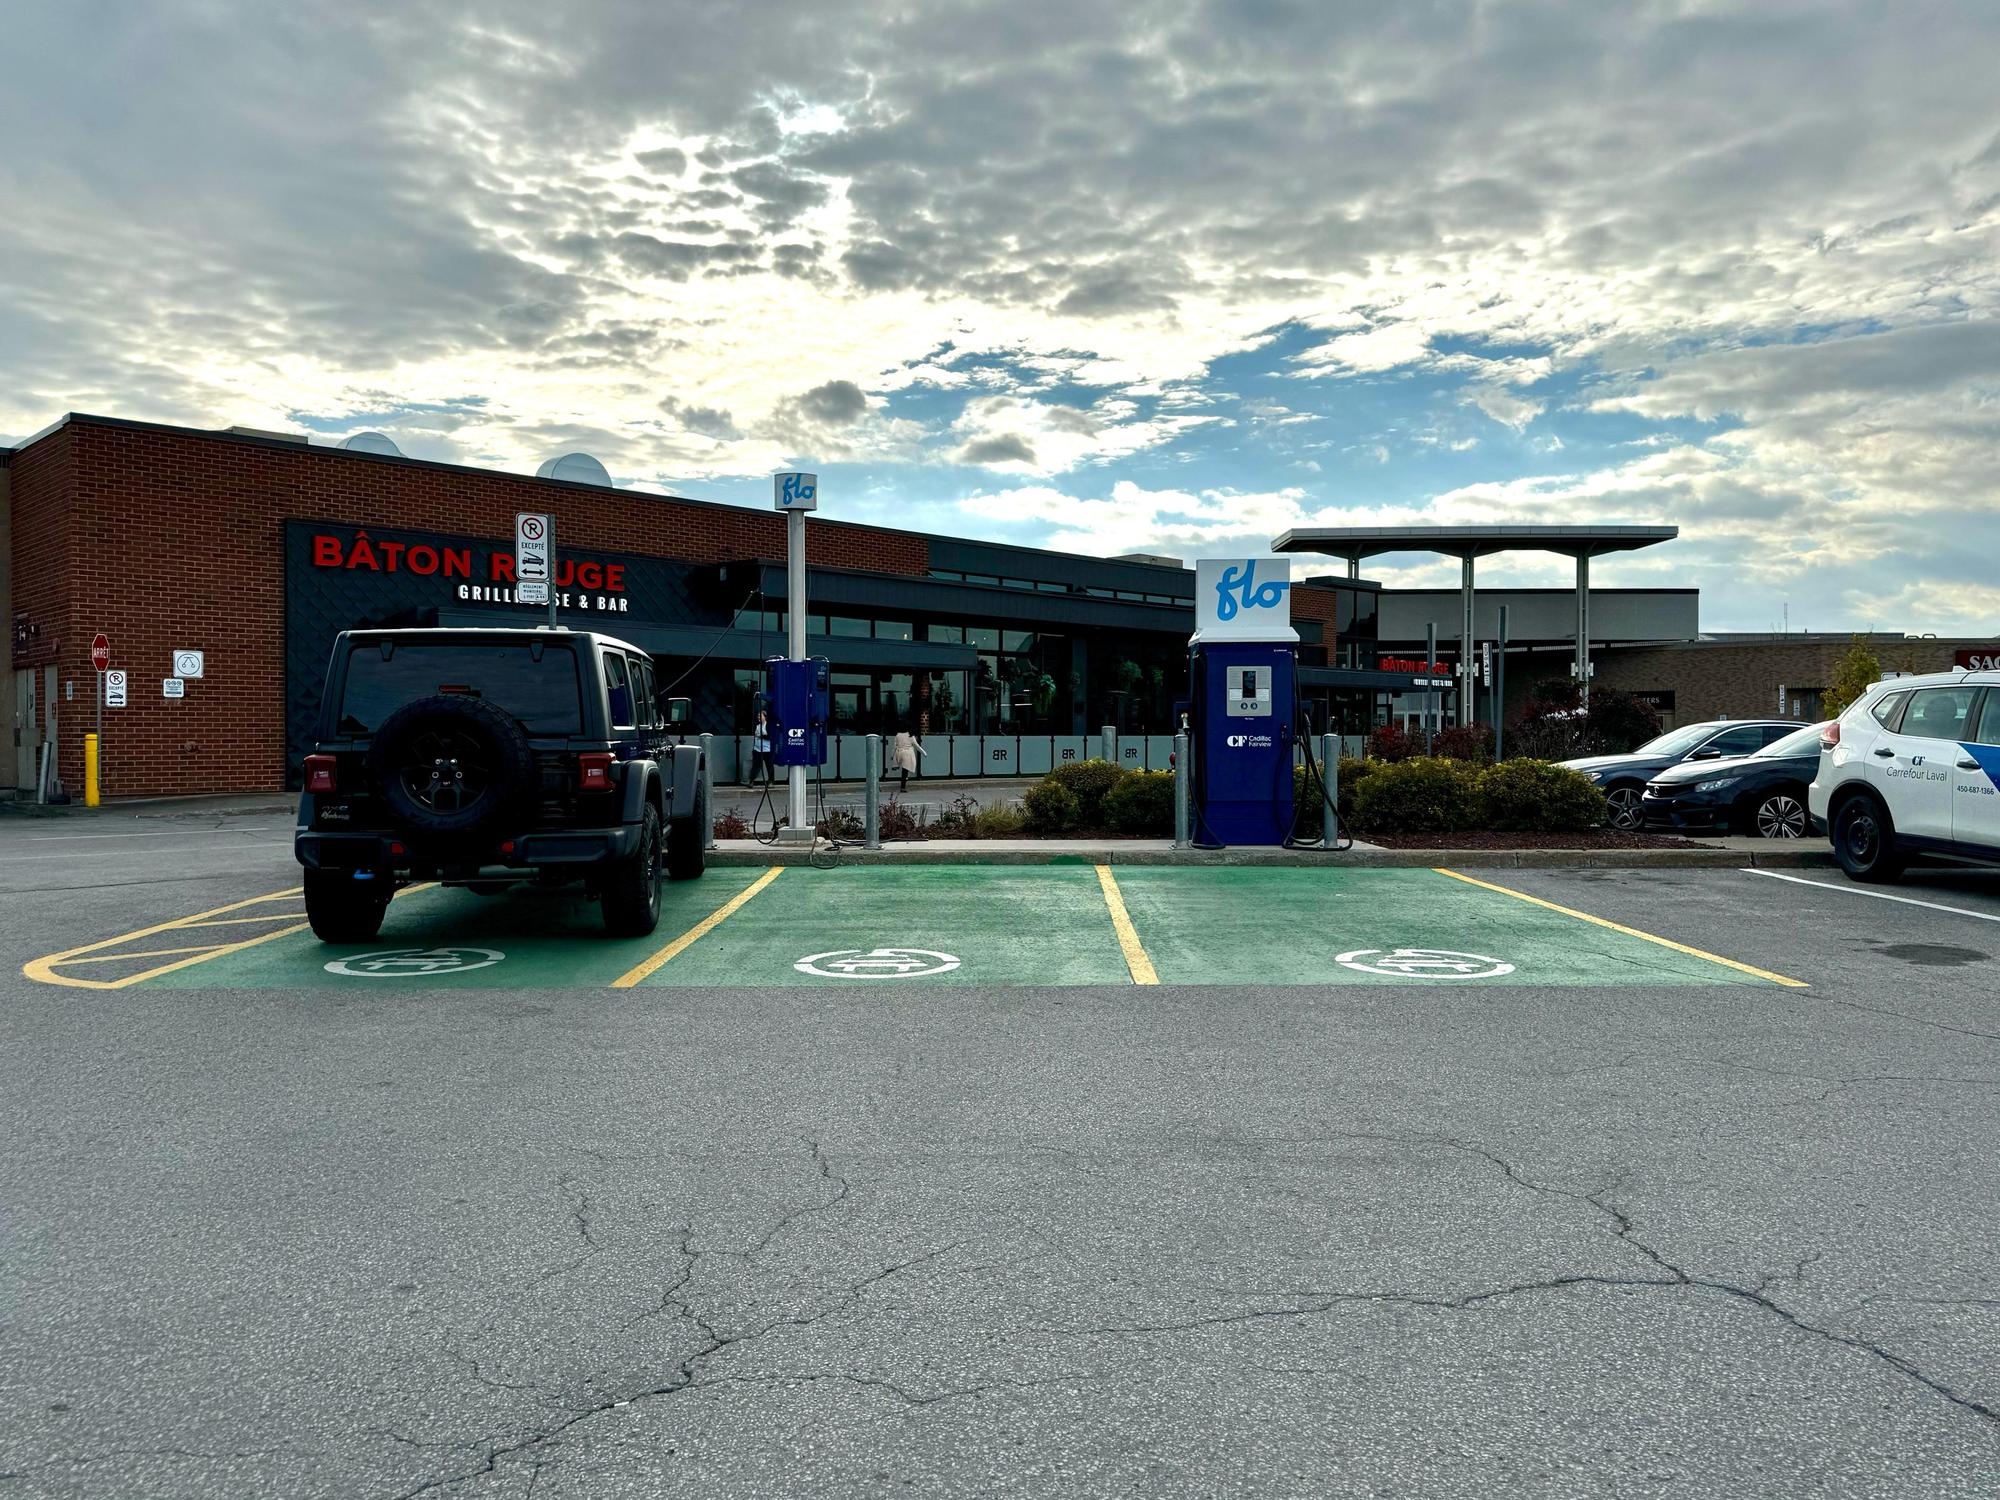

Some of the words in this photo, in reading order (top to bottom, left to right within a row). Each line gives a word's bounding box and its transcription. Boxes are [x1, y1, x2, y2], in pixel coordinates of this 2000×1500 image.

[782, 472, 815, 505] flo
[521, 541, 545, 551] EXCEPTÉ
[313, 530, 471, 578] BÂTON
[490, 552, 626, 592] RUGE
[1216, 559, 1290, 621] flo
[579, 594, 588, 609] &
[597, 596, 628, 612] BAR
[93, 645, 109, 658] ARRÊT
[1382, 655, 1414, 672] BÂTON
[788, 728, 805, 738] CF
[1227, 735, 1248, 747] CF
[1911, 755, 1926, 766] CF
[1886, 766, 1924, 780] Carrefour
[1926, 770, 1948, 782] Laval
[1957, 785, 1995, 796] 450-687-1366
